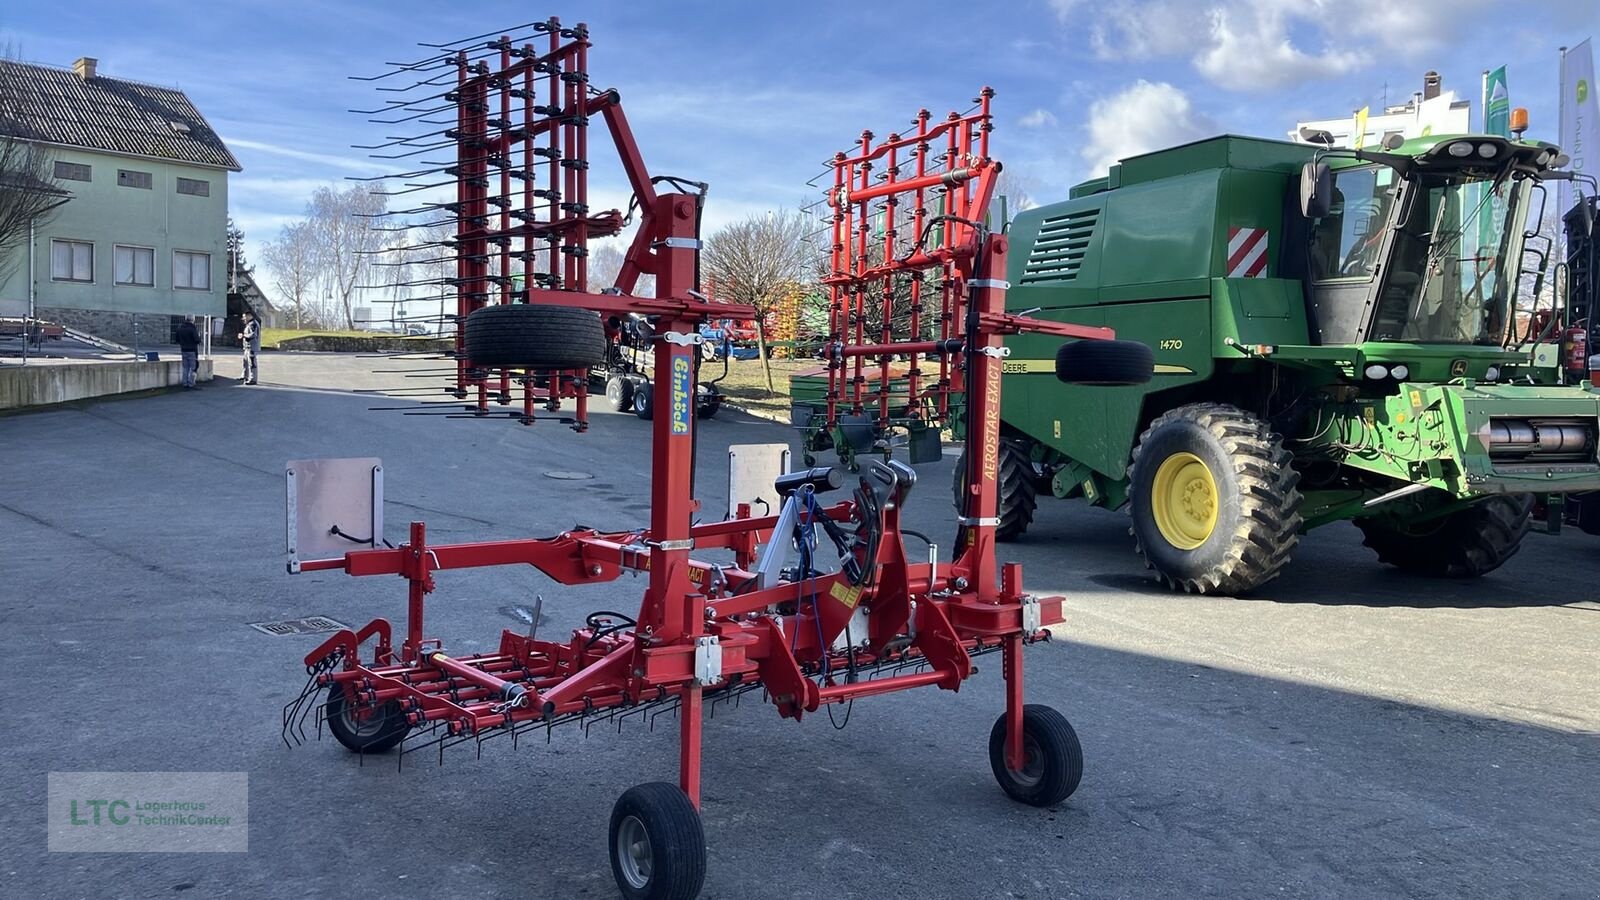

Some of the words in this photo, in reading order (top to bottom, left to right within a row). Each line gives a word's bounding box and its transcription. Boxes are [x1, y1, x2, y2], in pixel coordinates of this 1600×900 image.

[1160, 339, 1183, 350] 1470
[1002, 362, 1027, 372] DEERE
[673, 358, 689, 433] Einböck
[984, 362, 999, 480] AEROSTAR-EXACT
